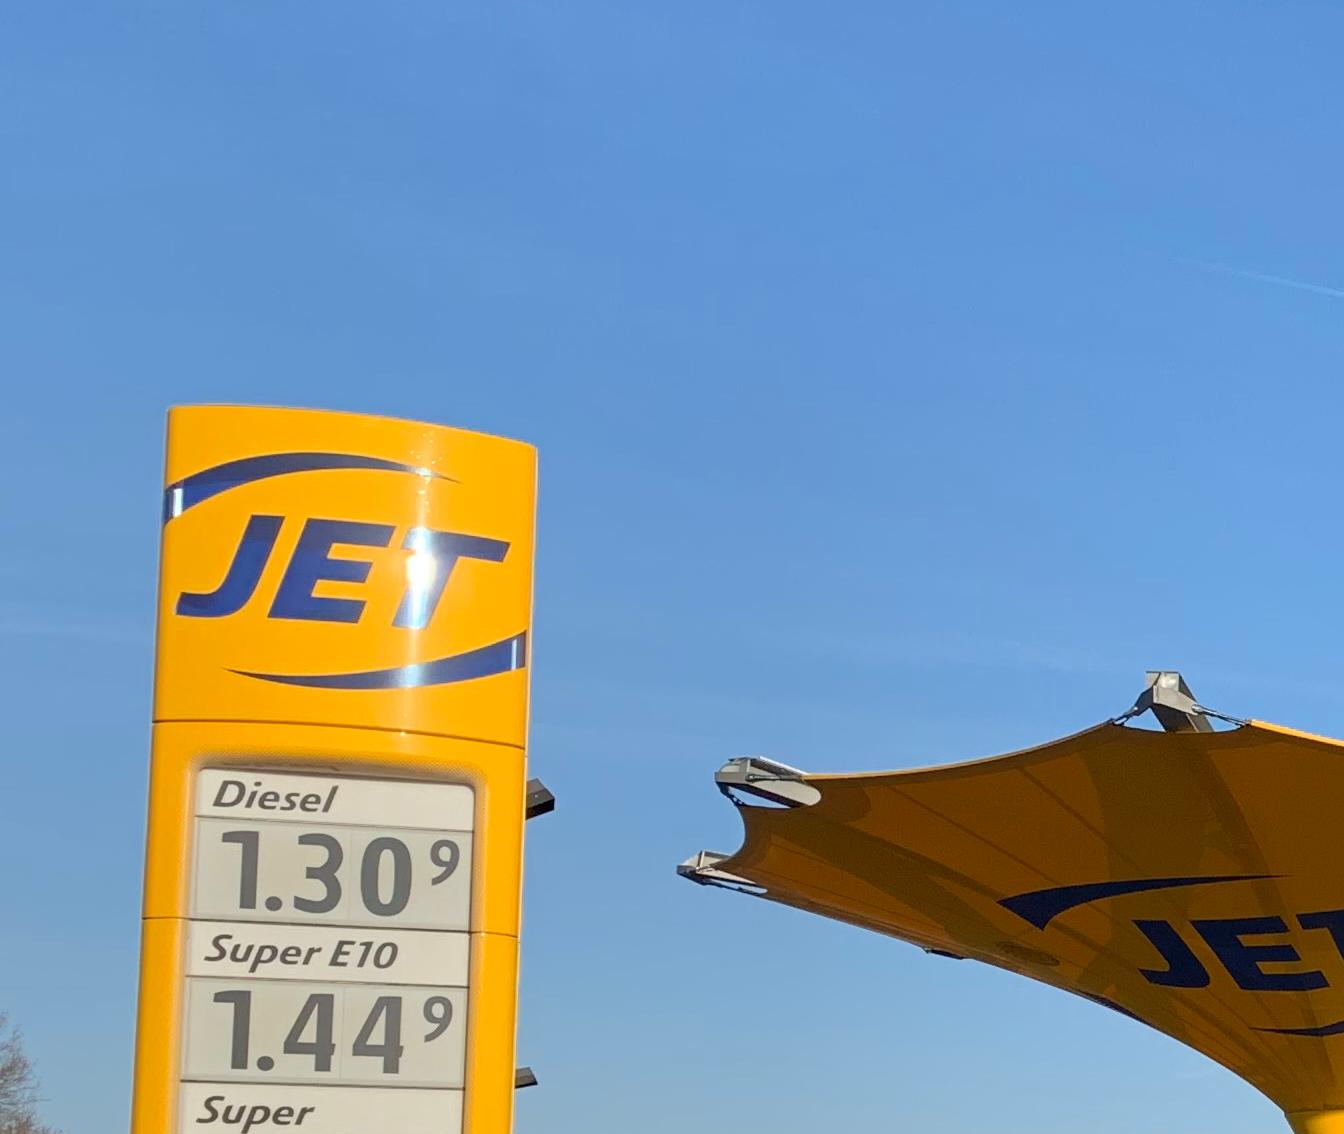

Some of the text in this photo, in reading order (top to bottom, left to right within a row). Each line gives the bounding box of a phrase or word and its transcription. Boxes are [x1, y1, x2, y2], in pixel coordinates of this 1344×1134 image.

[174, 514, 511, 630] JET
[212, 780, 339, 813] Diesel
[203, 934, 399, 974] Super E10
[195, 1095, 316, 1134] Super
